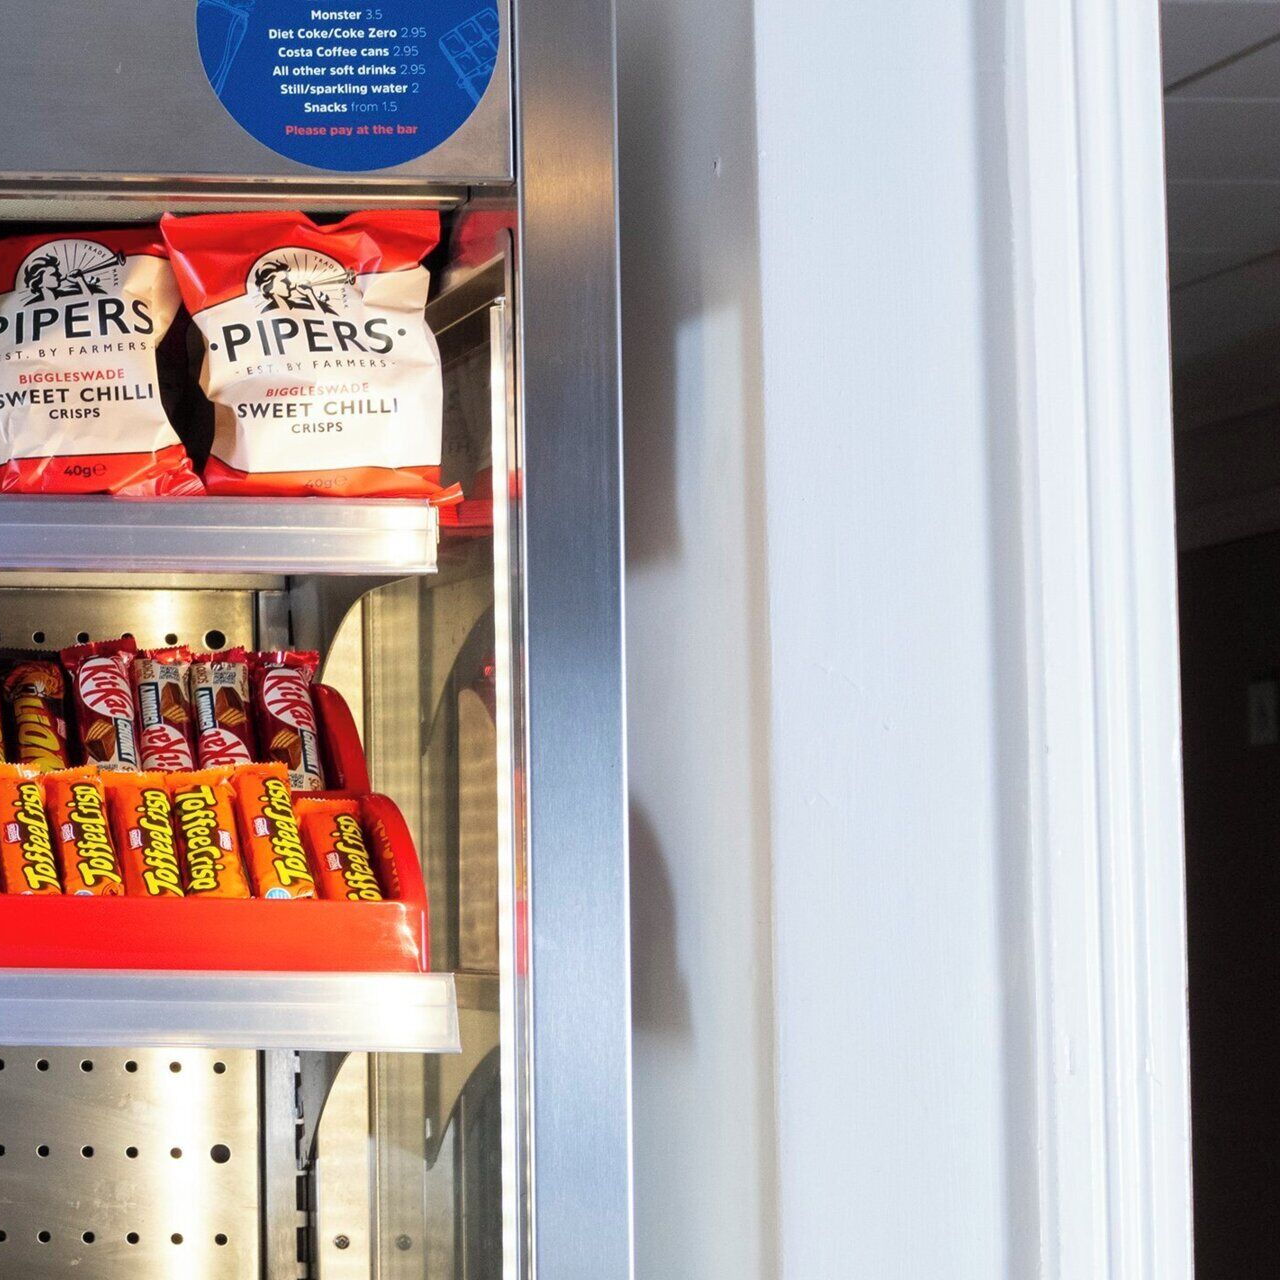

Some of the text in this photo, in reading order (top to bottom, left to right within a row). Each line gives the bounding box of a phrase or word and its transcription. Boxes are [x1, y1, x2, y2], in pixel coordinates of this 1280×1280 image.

[311, 10, 383, 20] Monster 3.5
[268, 28, 426, 39] Diet Coke/Coke Zero 2.95
[278, 46, 419, 58] Costa Coffee cans 2.95
[273, 64, 426, 76] All other soft drinks 2.95
[280, 83, 419, 95] Still/sparkling water 2
[304, 101, 397, 113] Snacks from 1.5
[286, 124, 418, 137] Please pay at the bar
[222, 318, 394, 362] PIPERS
[19, 369, 125, 385] BIGGLESWADE
[80, 383, 153, 402] CHILLI
[237, 398, 398, 418] SWEET CHILLI
